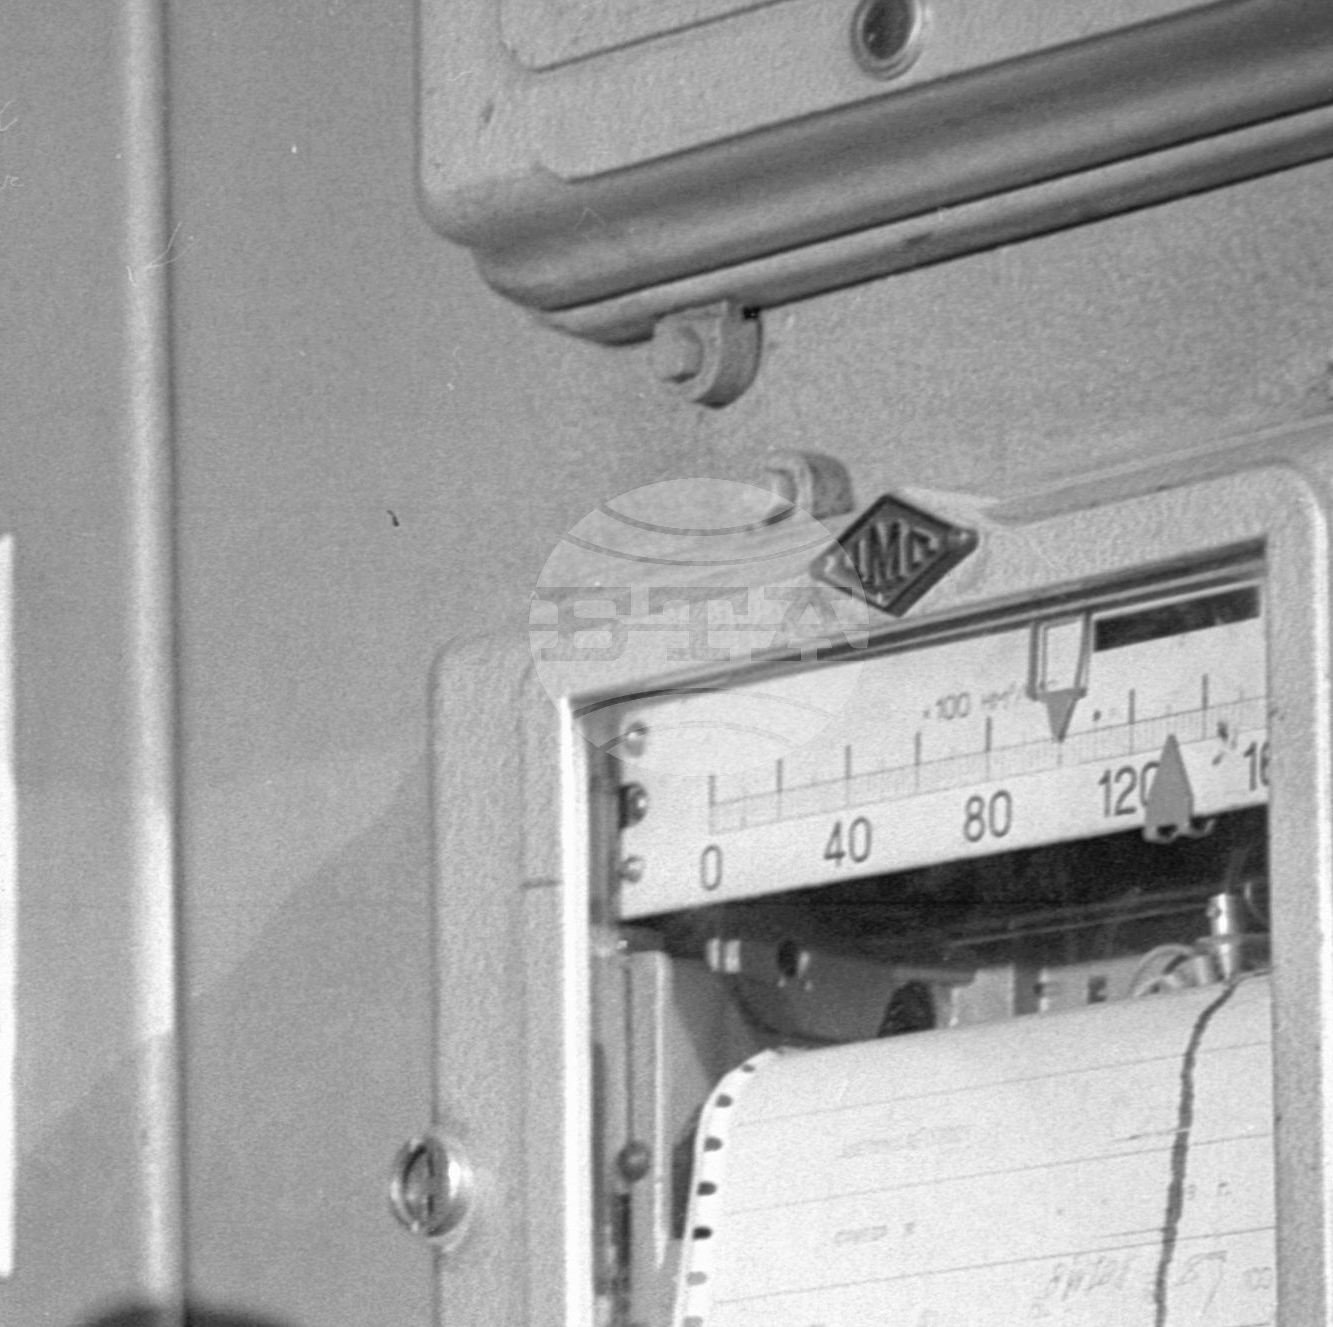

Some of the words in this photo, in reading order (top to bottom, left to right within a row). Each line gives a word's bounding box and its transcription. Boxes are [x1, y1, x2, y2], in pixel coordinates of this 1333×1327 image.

[700, 844, 723, 891] 0
[823, 816, 873, 867] 40
[962, 789, 1013, 842] 80
